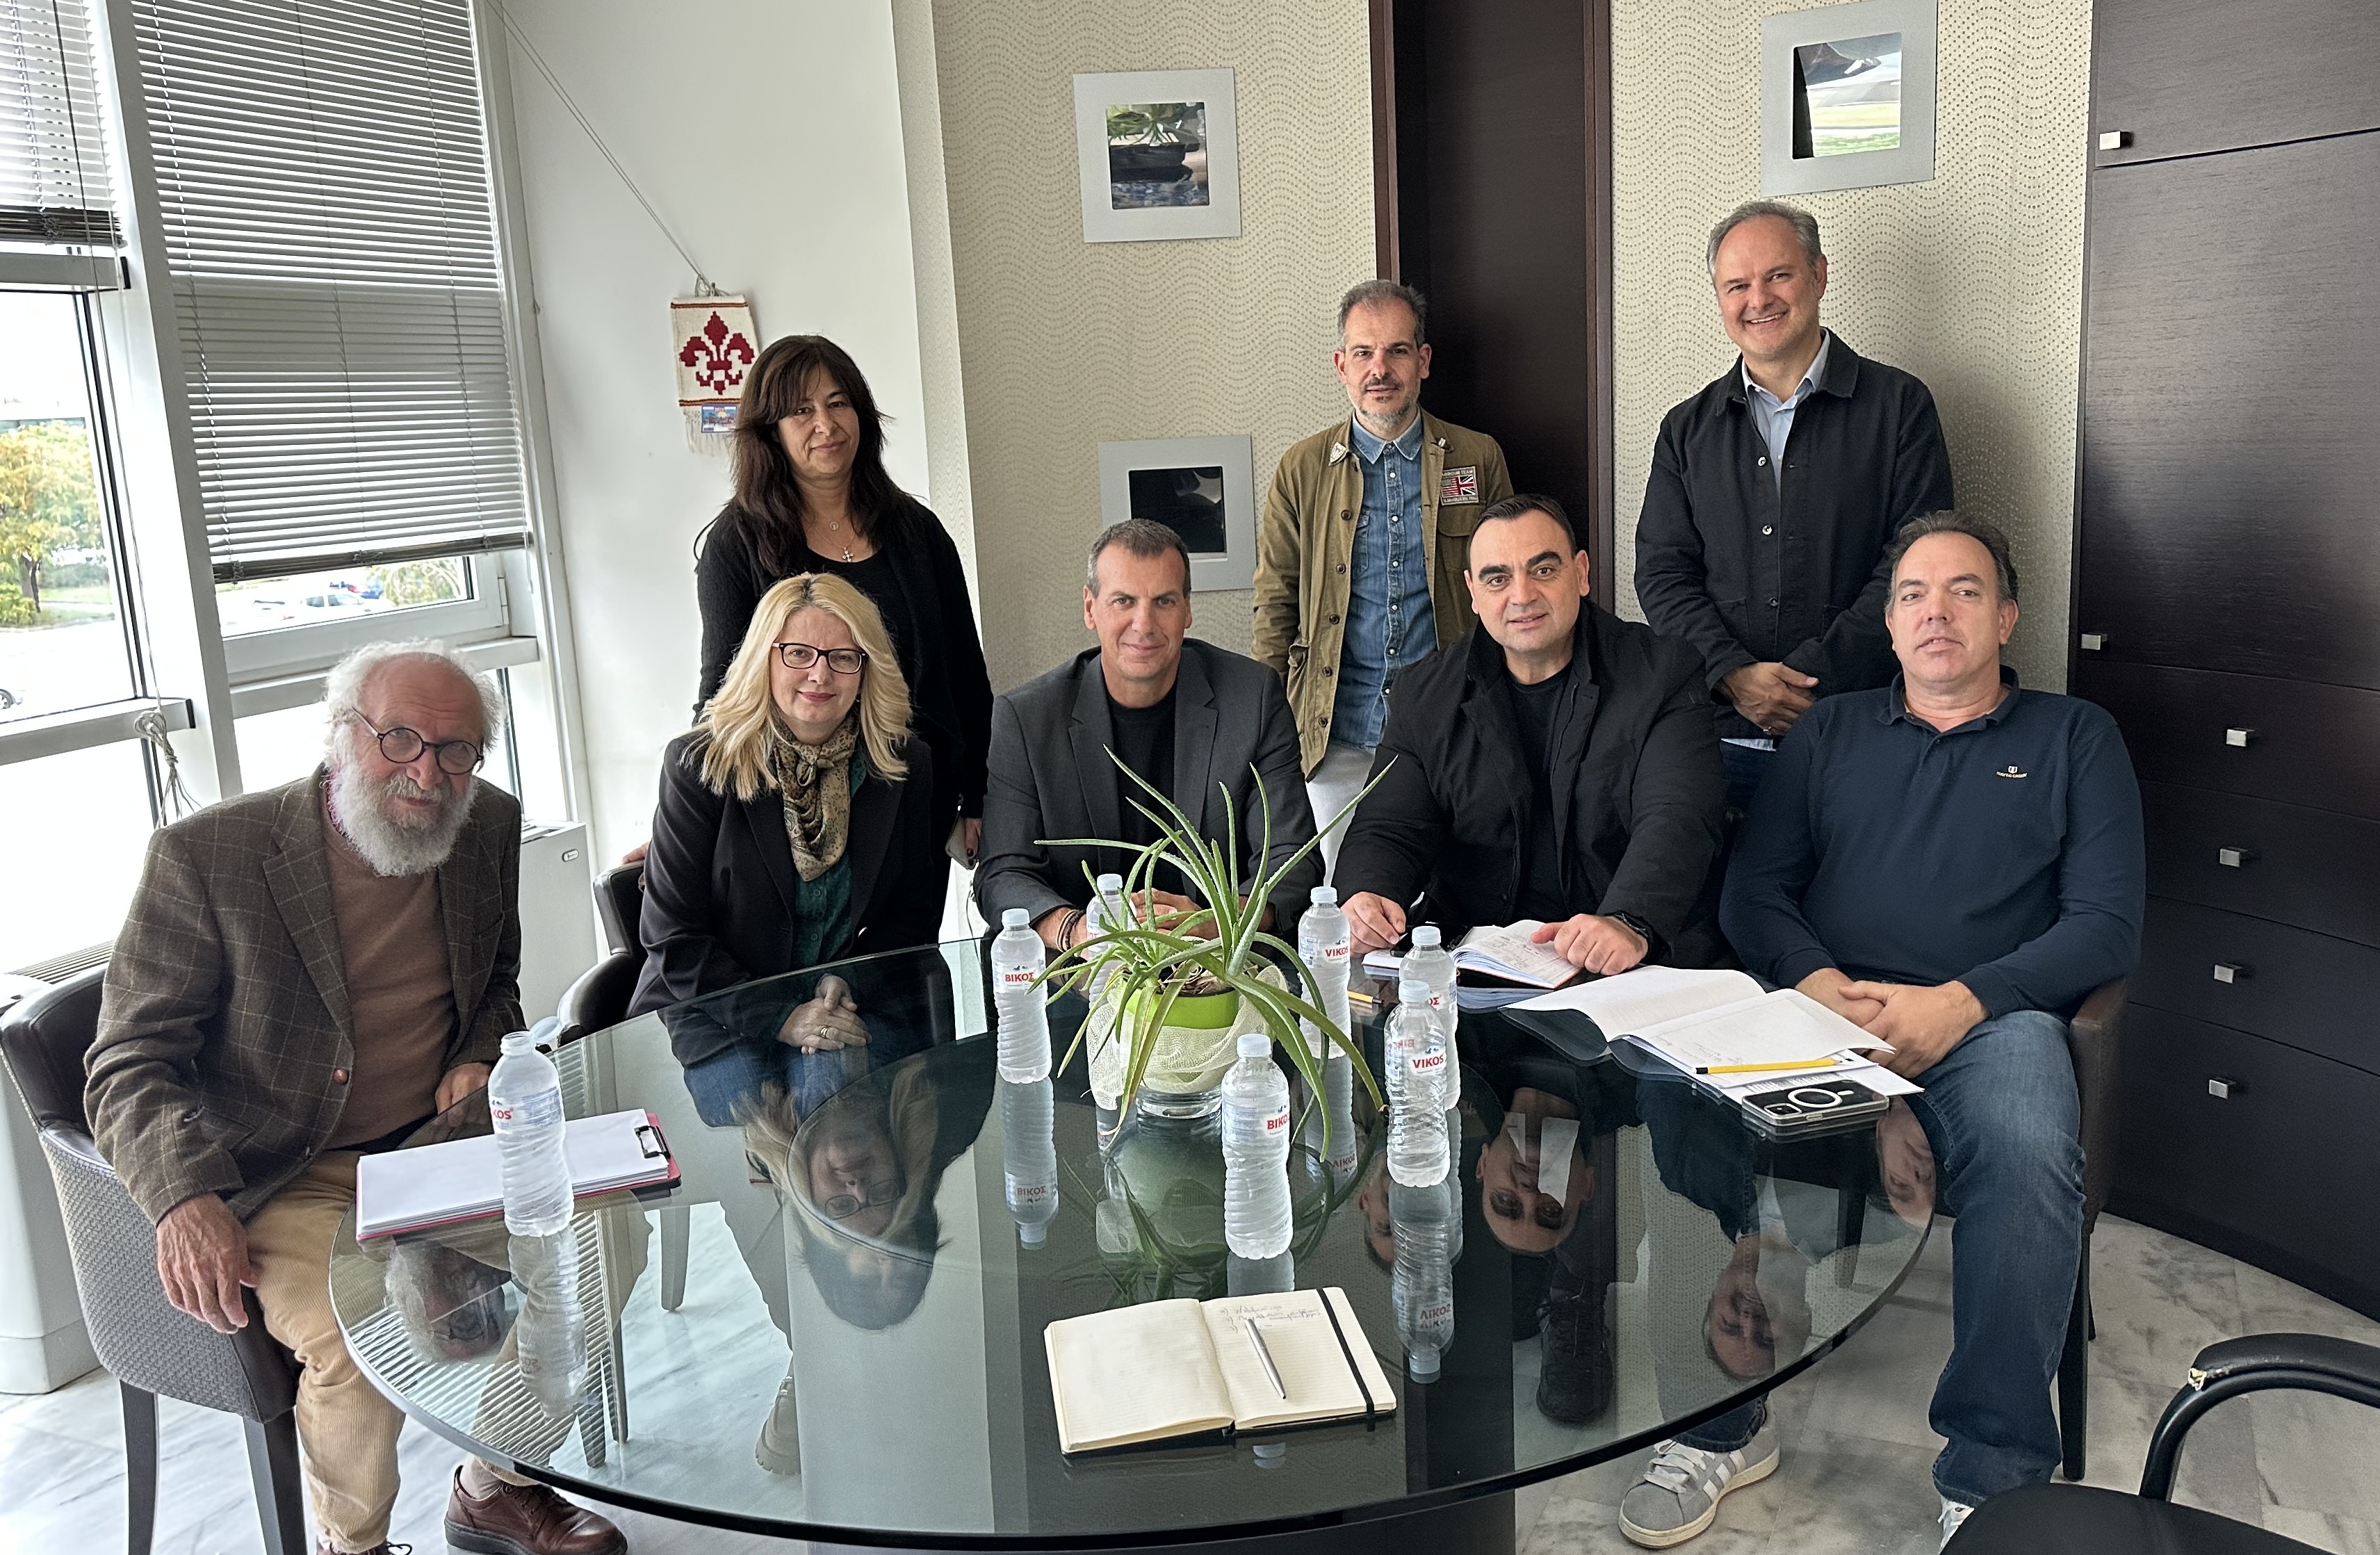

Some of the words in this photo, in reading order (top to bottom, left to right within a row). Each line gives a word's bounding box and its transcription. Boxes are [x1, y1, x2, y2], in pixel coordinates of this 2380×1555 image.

[1325, 946, 1348, 957] VIKOS
[1005, 972, 1034, 982] ΒΙΚΟΣ
[1412, 1052, 1444, 1068] VIKOS
[1267, 1114, 1289, 1130] ΒΙΚΟ
